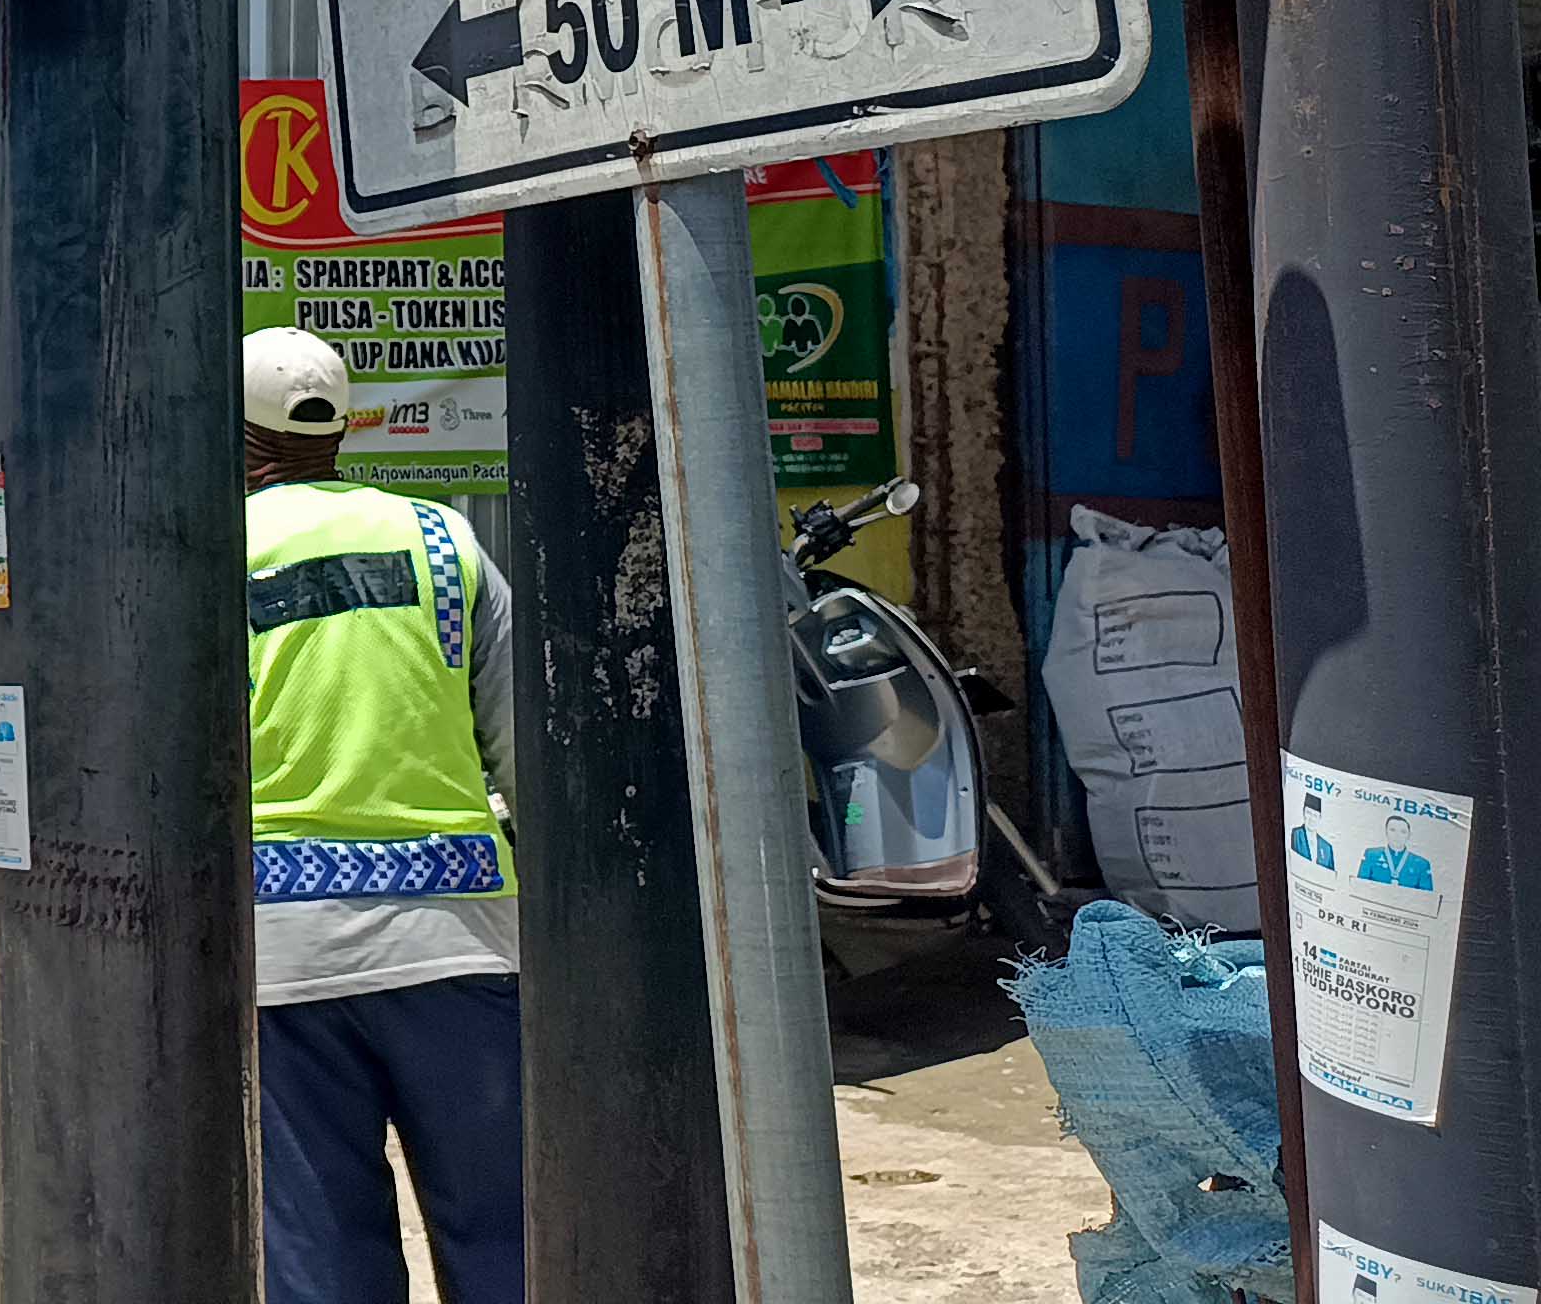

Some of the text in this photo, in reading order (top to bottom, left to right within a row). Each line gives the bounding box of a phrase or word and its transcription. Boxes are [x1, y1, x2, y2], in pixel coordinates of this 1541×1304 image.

[296, 260, 430, 288] SPAREPART
[438, 264, 453, 287] &
[298, 301, 372, 329] PULSA
[391, 300, 465, 329] TOKEN
[352, 341, 383, 369] UP
[389, 340, 454, 369] DANA
[461, 408, 493, 421] Three
[371, 464, 468, 484] Arjowinangun
[1355, 788, 1390, 806] SUKA
[1318, 909, 1367, 933] DPR RI
[1302, 941, 1318, 961] 14
[1339, 957, 1371, 971] PARTAI
[1339, 963, 1390, 984] DEMOKRAT
[1302, 958, 1332, 983] EDHIE
[1337, 974, 1416, 1007] BASKORO
[1302, 972, 1415, 1019] YUDHOYONO
[1356, 1255, 1402, 1283] SBY?
[1417, 1277, 1456, 1296] SUKA
